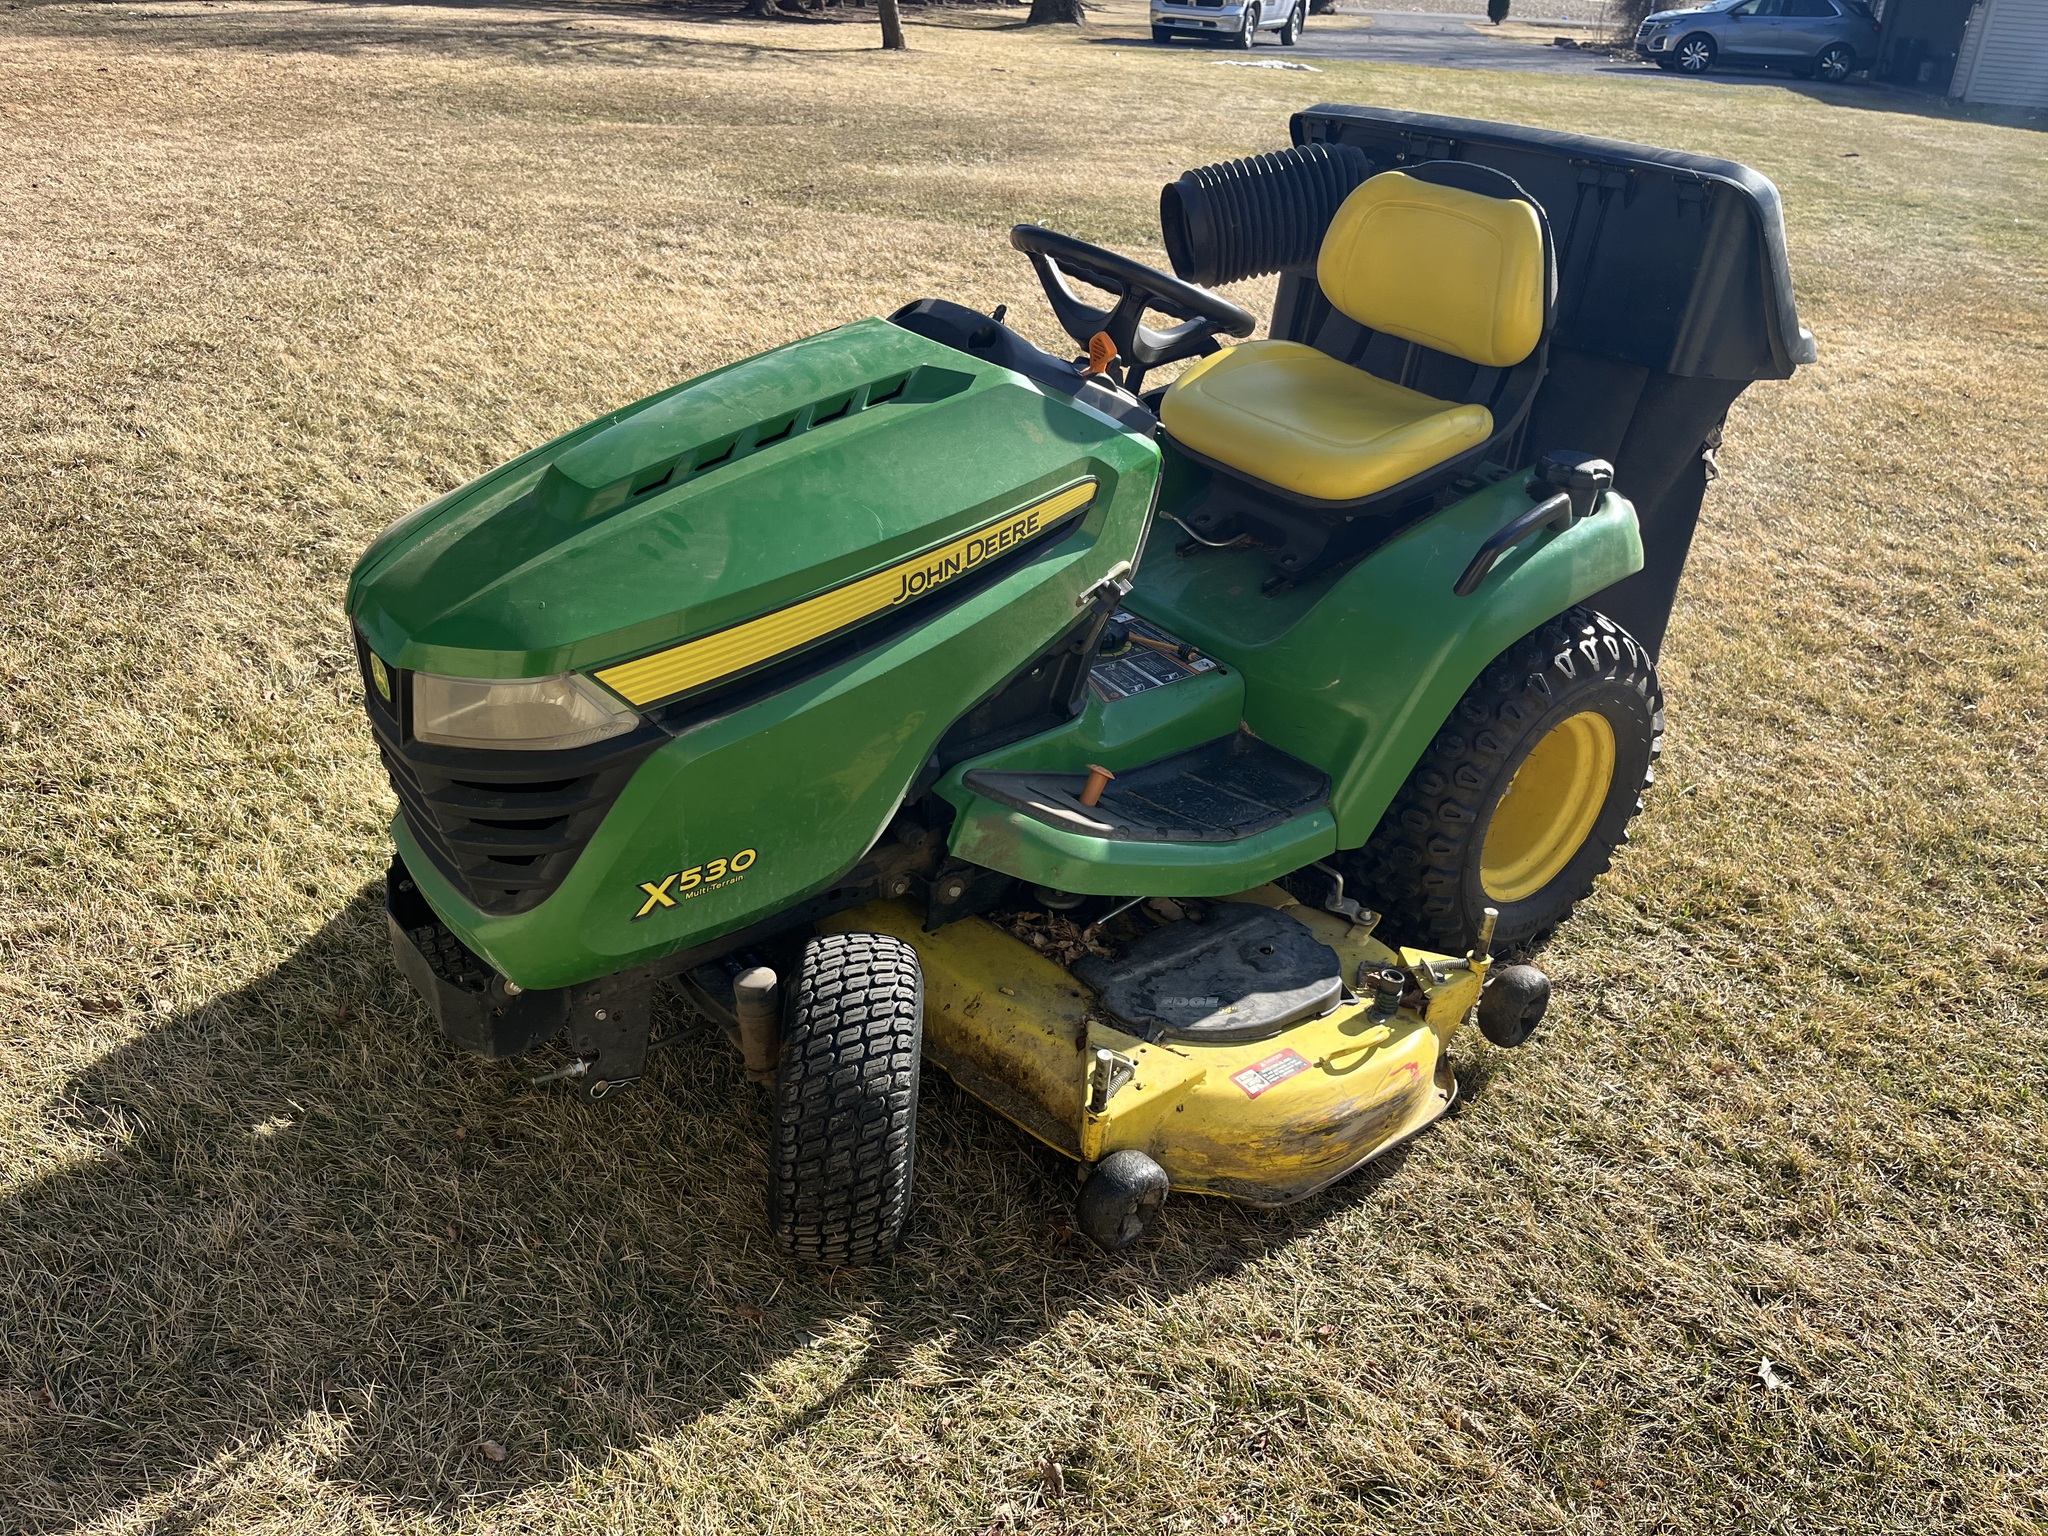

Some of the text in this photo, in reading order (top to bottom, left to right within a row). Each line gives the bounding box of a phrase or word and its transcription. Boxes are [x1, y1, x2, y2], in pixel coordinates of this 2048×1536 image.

[893, 511, 1042, 603] JOHN DEERE
[633, 847, 758, 919] X530
[684, 874, 744, 899] Multi-Terrain
[1160, 996, 1219, 1008] EDGE
